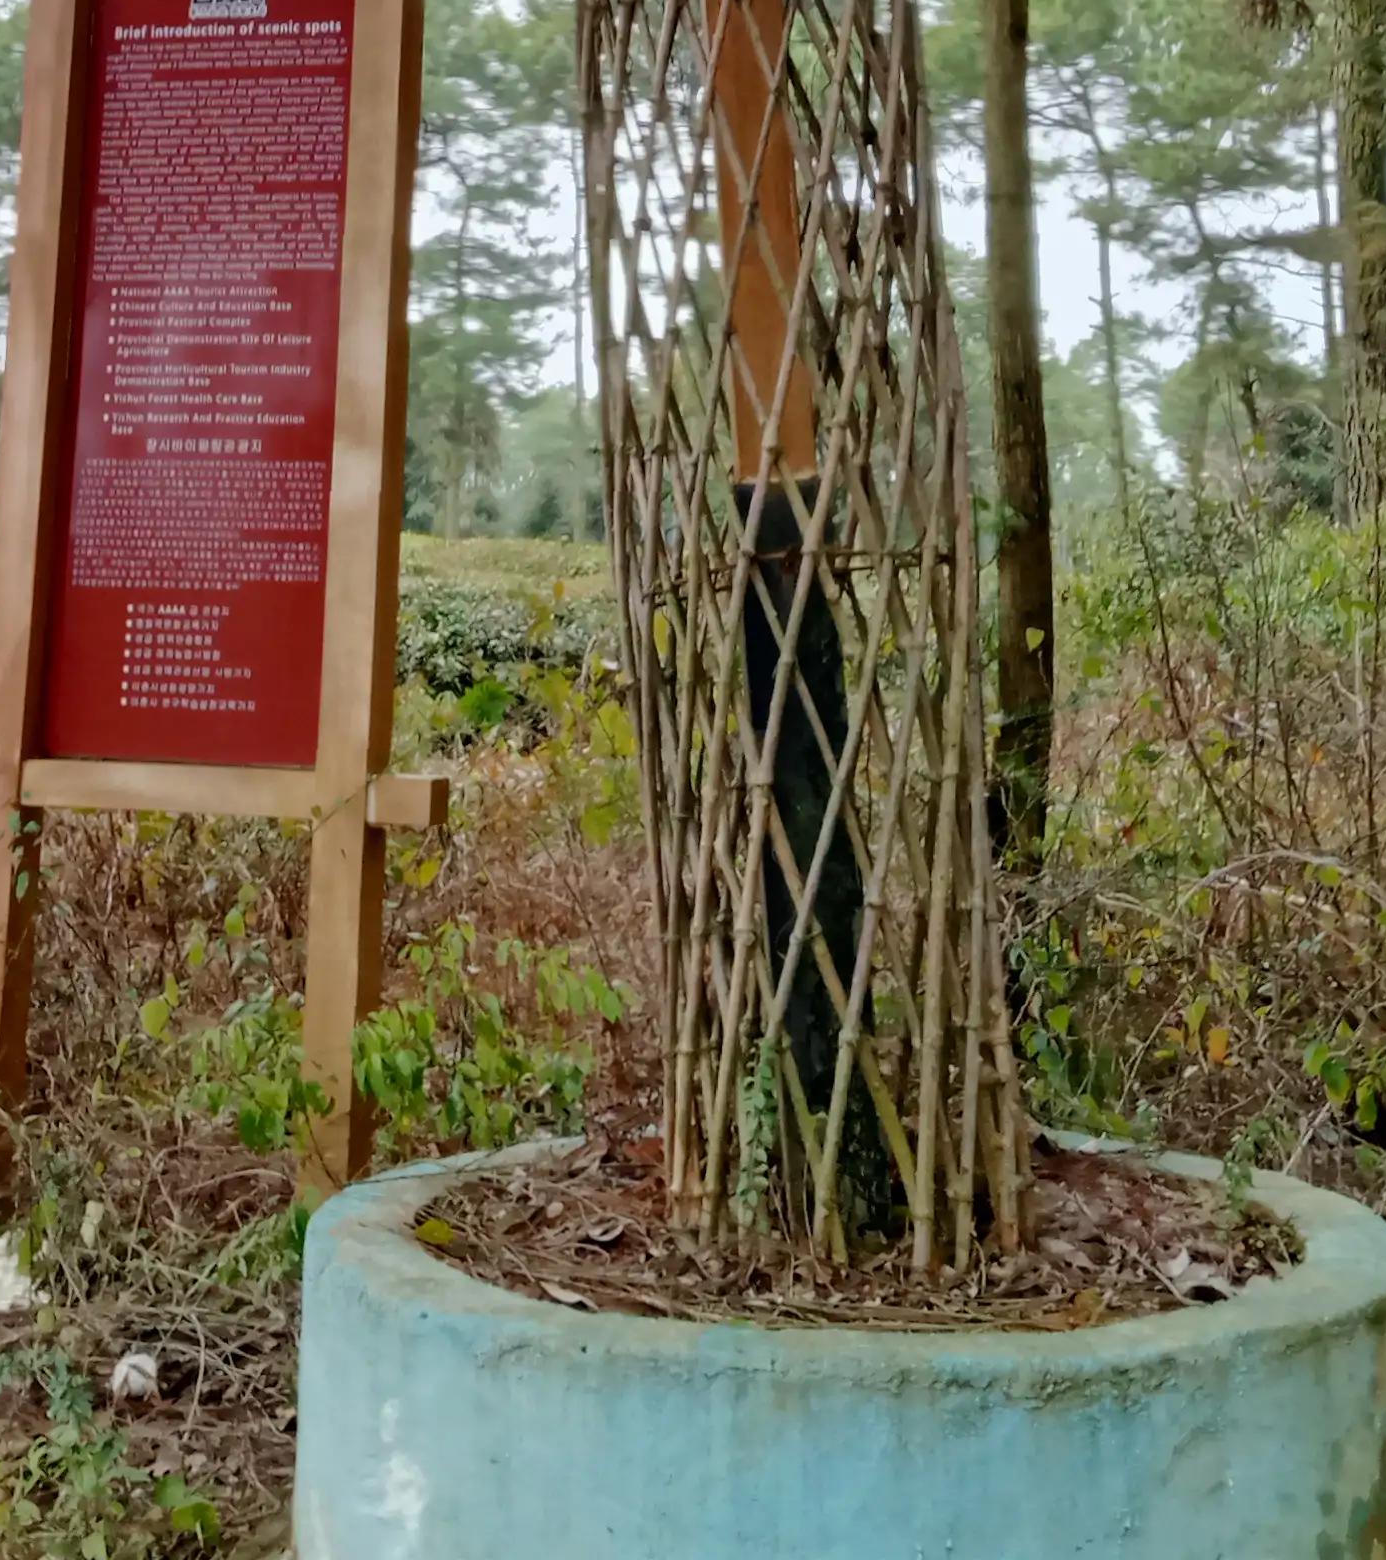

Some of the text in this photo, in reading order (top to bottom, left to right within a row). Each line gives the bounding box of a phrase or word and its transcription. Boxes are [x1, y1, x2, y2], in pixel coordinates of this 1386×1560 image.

[114, 19, 342, 40] Brief introduction of scenic spots
